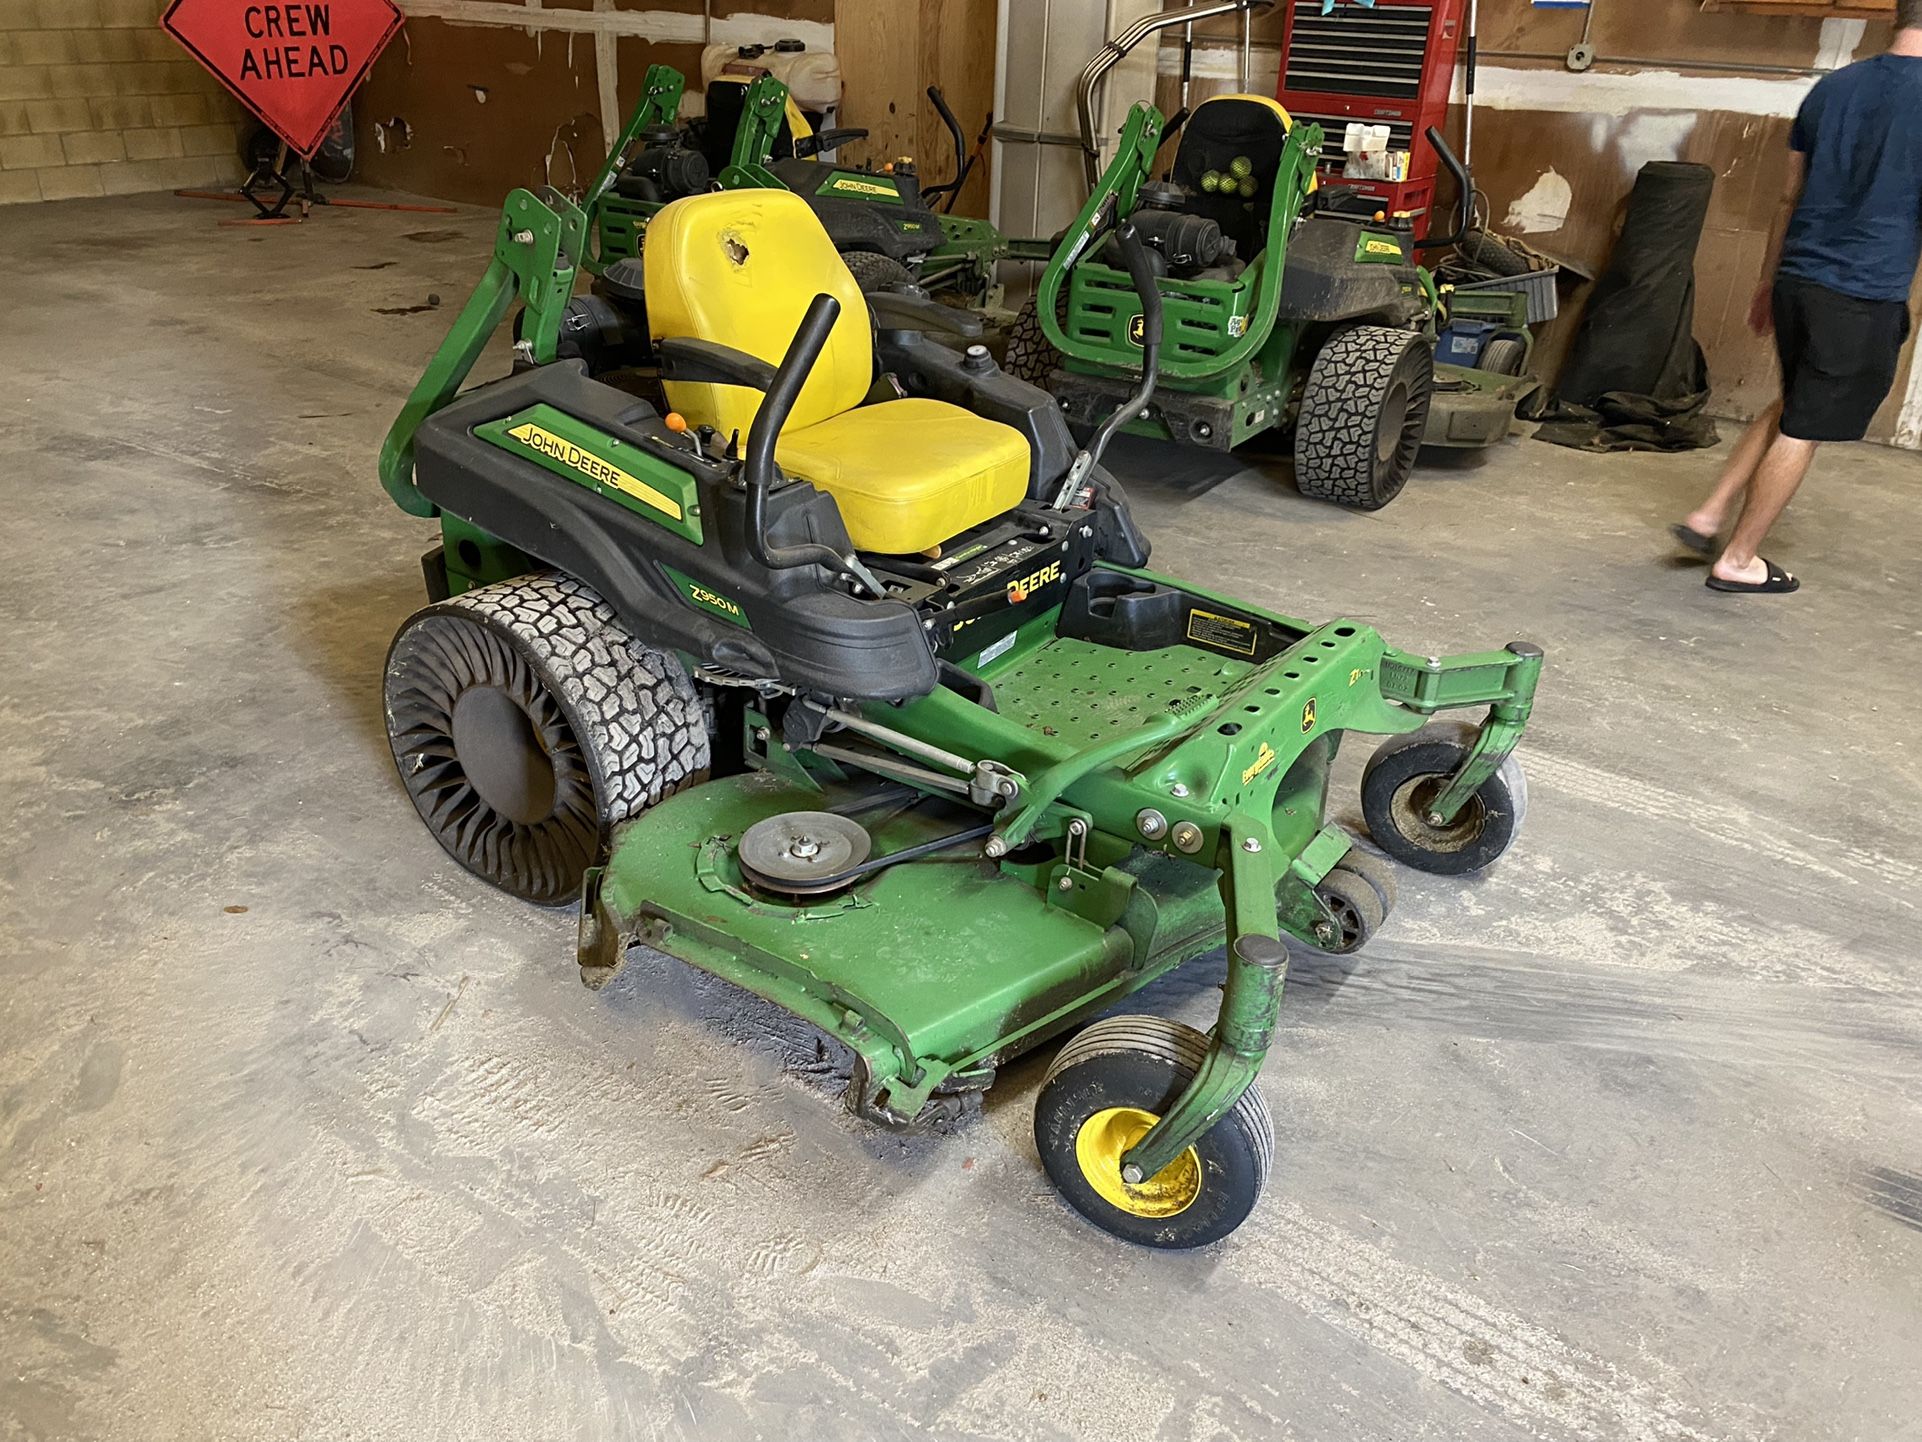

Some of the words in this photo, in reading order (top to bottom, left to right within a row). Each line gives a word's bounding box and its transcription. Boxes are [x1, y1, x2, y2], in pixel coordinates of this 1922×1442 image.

[244, 4, 330, 39] CREW
[240, 44, 349, 80] AHEAD
[839, 181, 857, 190] JOHN
[857, 183, 877, 193] DEERE
[523, 427, 566, 460] JOHN
[567, 447, 621, 487] DEERE
[689, 584, 740, 616] Z950M
